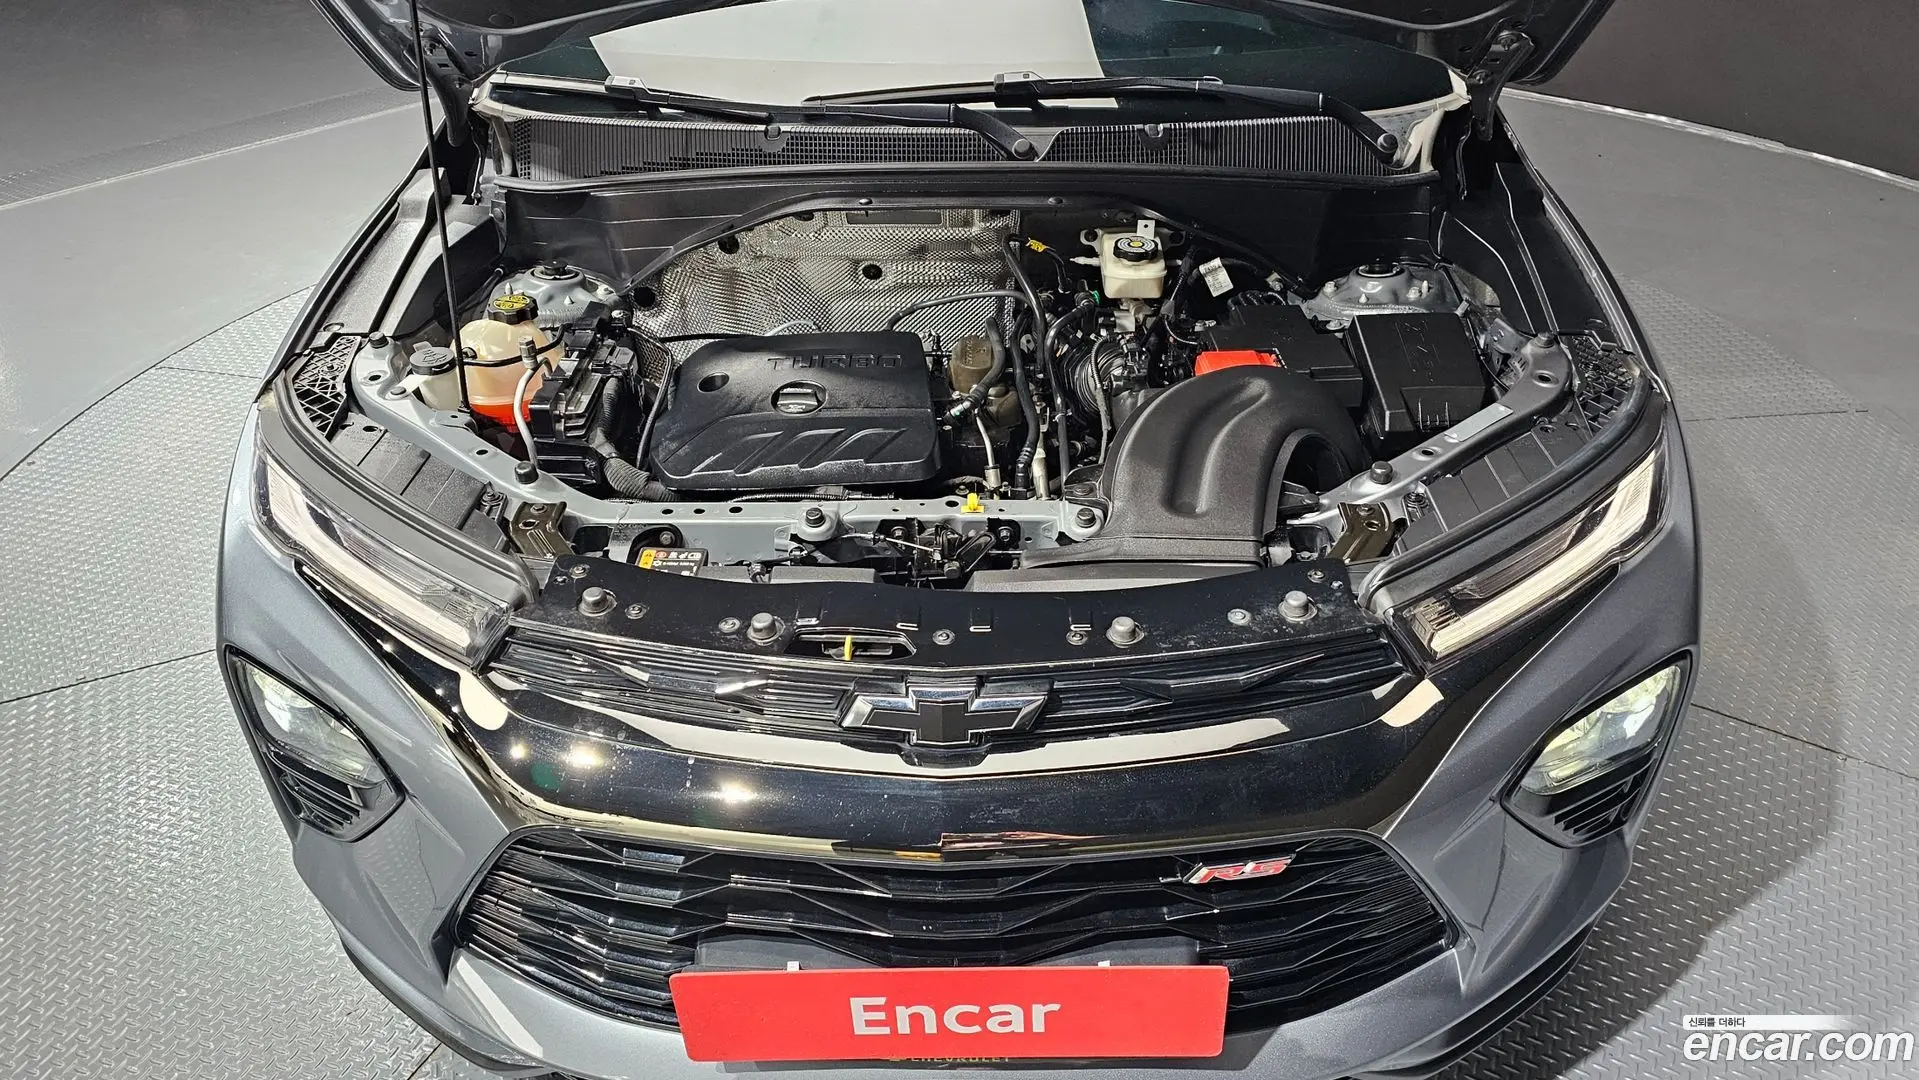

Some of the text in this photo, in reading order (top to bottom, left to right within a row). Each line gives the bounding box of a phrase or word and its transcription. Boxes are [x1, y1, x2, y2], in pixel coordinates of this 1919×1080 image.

[768, 353, 902, 370] TURBO
[1187, 855, 1294, 885] RS
[849, 996, 1062, 1037] Encar
